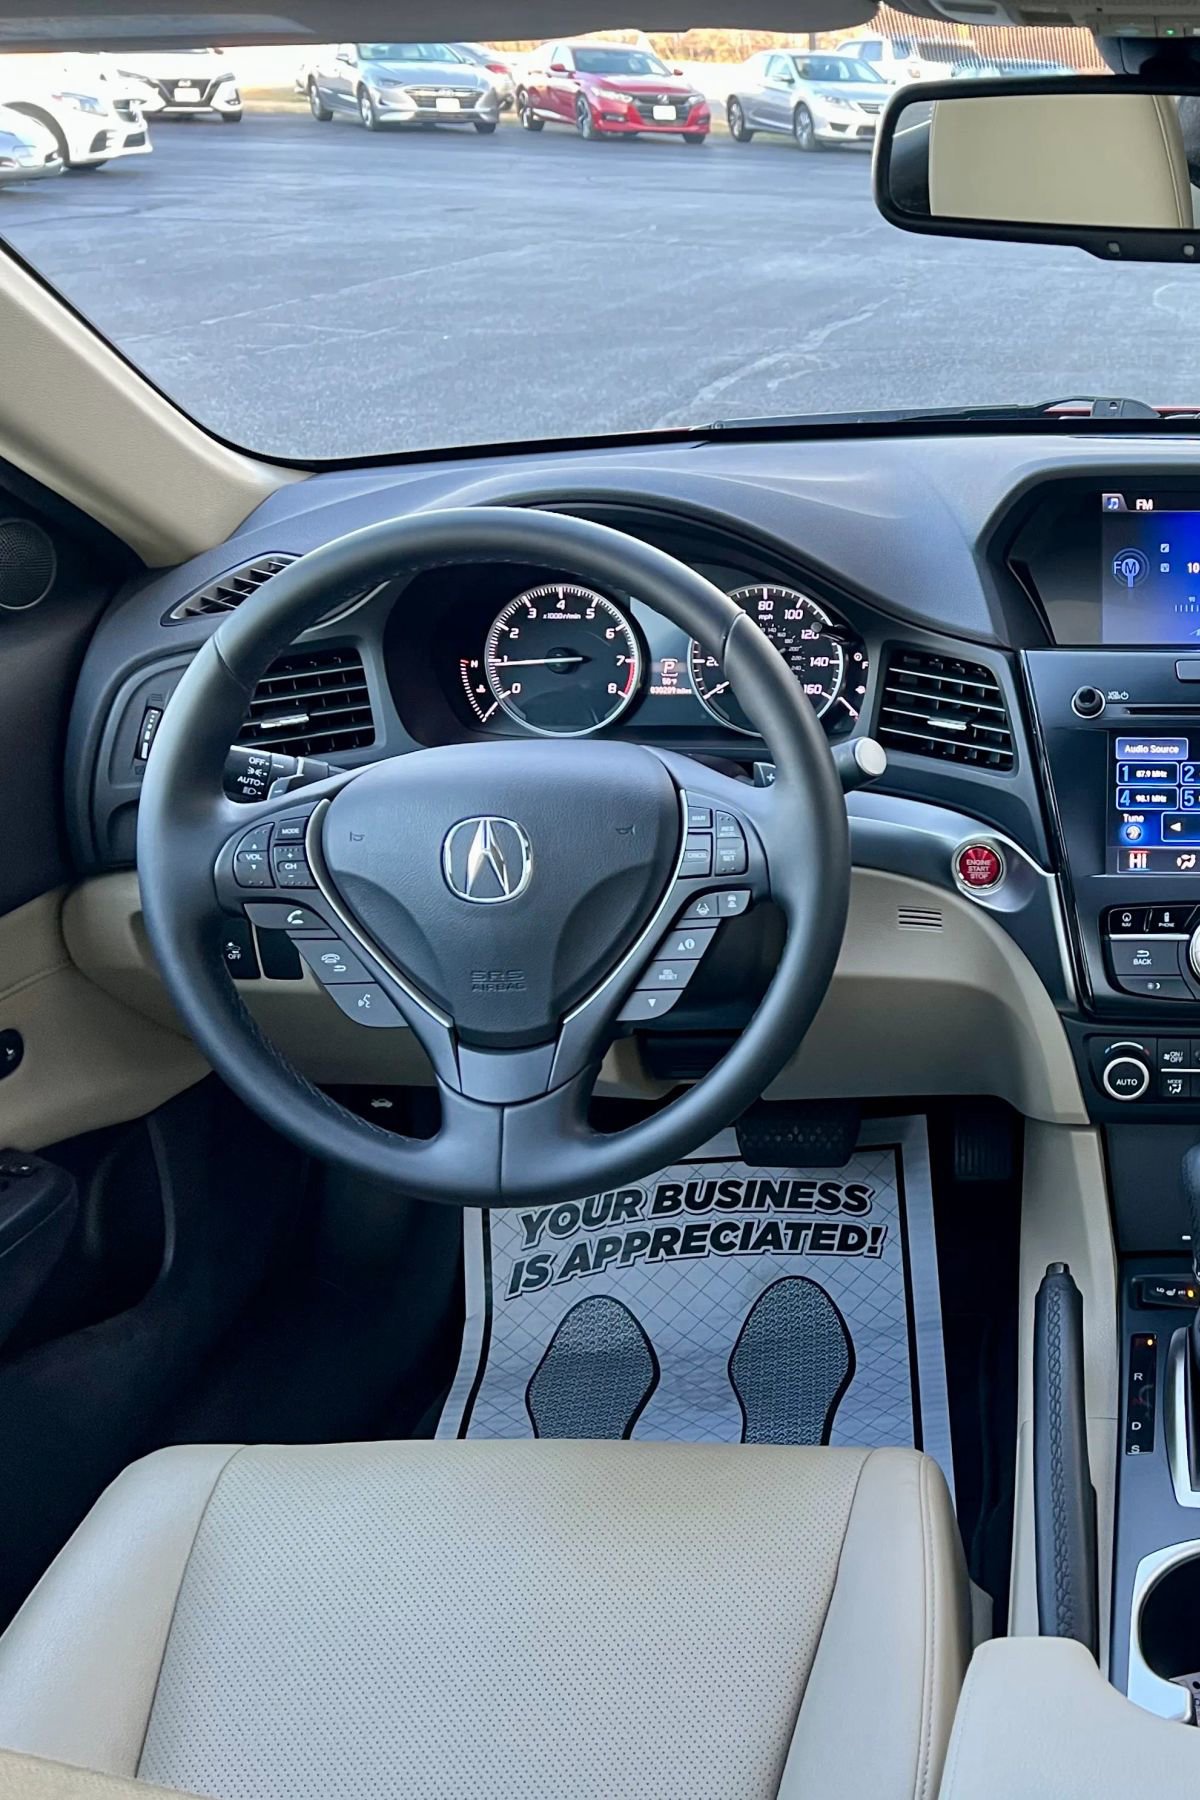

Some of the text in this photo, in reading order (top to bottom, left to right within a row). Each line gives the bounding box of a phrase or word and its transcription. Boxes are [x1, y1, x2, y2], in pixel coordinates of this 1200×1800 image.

[1136, 499, 1153, 510] FM
[556, 601, 565, 610] 4
[758, 601, 774, 611] 80
[527, 608, 537, 619] 3
[585, 607, 595, 619] 5
[784, 609, 803, 620] 100
[509, 628, 519, 638] 2
[605, 628, 615, 638] 6
[616, 655, 626, 666] 7
[810, 657, 829, 667] 140
[511, 683, 521, 694] 0
[607, 683, 617, 694] 8
[1124, 745, 1179, 754] Audio Source
[248, 756, 266, 766] OFF
[1122, 765, 1129, 782] 1
[1183, 765, 1195, 782] 2
[237, 776, 260, 787] AUTO
[1120, 790, 1130, 806] 4
[1183, 790, 1195, 806] 5
[1123, 814, 1144, 823] Tune
[228, 952, 242, 960] OFF
[471, 982, 527, 993] AIRBAG
[1116, 1078, 1138, 1086] AUTO
[519, 1178, 873, 1248] YOUR BUSINESS
[506, 1219, 888, 1298] IS APPRECIATED!
[1132, 1422, 1141, 1430] D
[1131, 1445, 1140, 1453] S
